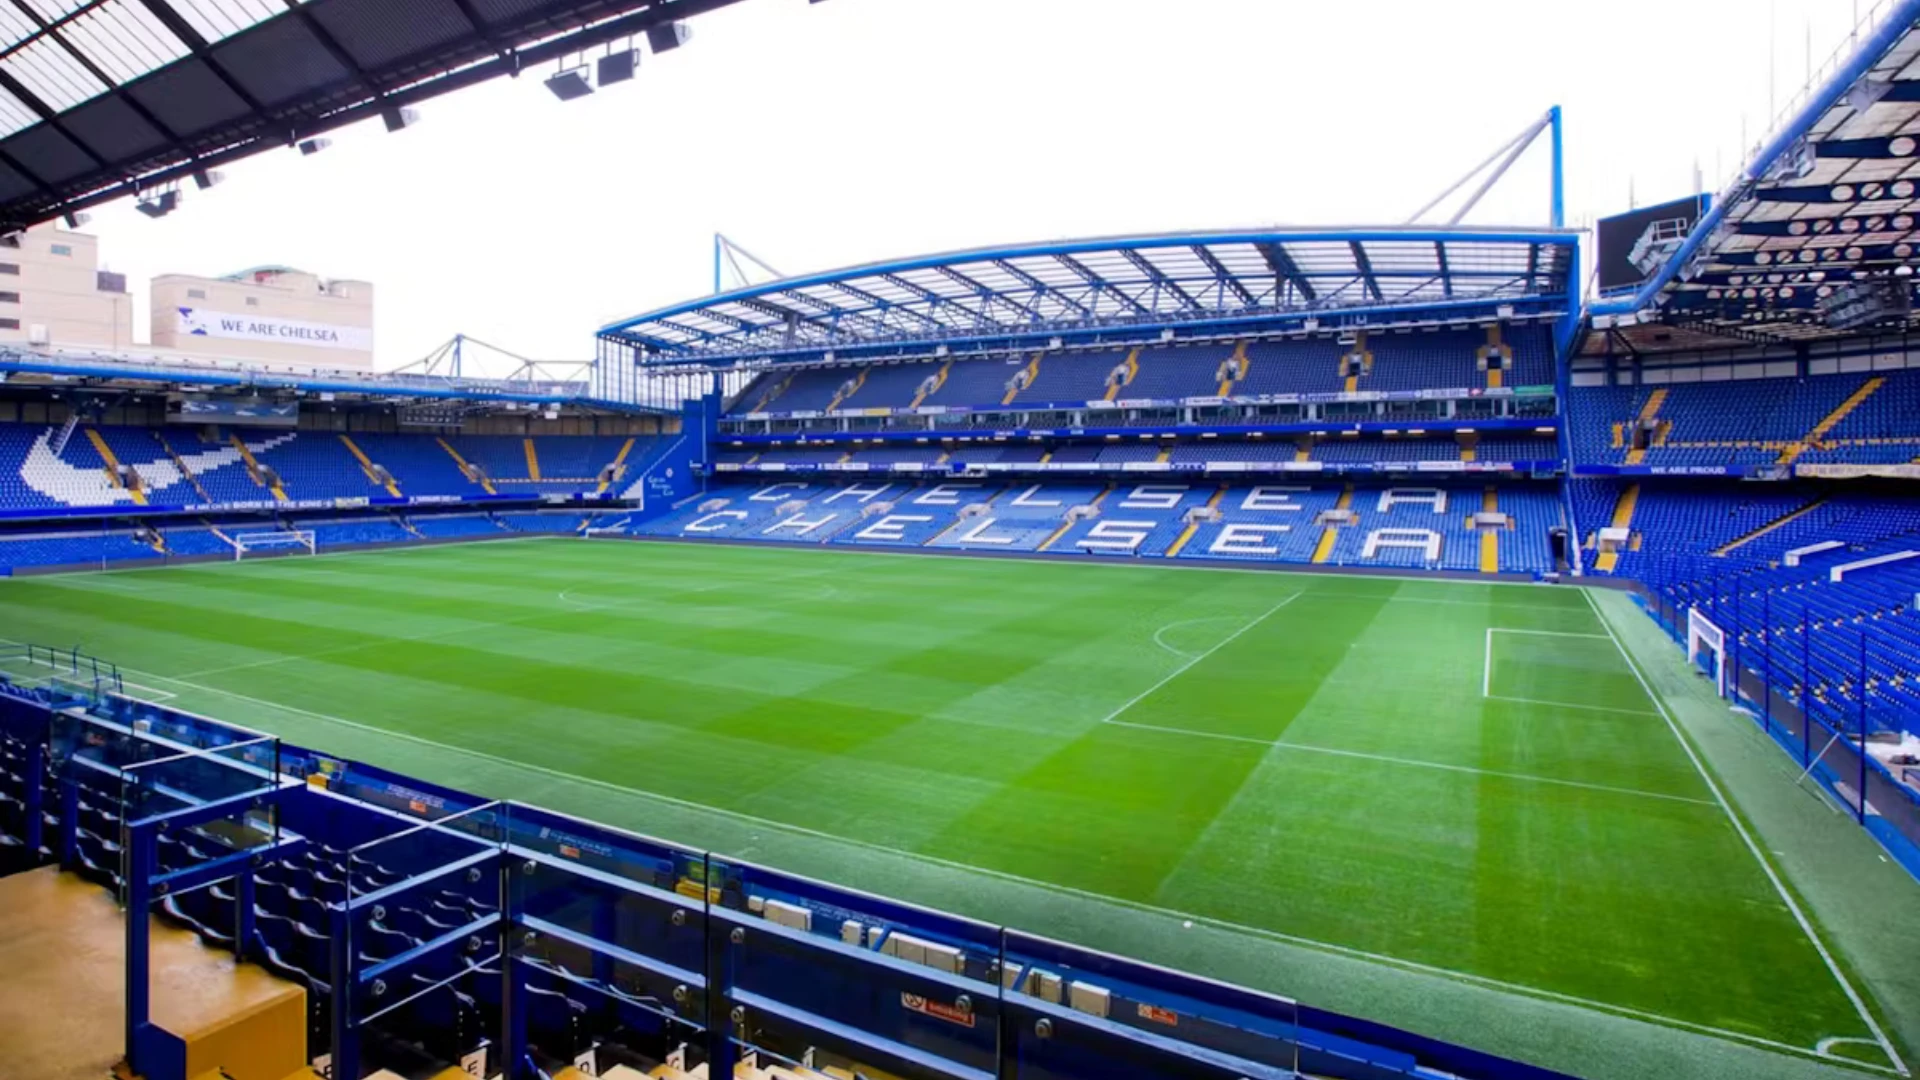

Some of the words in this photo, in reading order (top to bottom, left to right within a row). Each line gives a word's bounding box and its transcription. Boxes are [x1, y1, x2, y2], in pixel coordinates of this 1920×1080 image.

[221, 319, 243, 332] WE
[248, 322, 276, 336] ARE
[279, 325, 339, 342] CHELSEA
[1651, 466, 1666, 475] WE
[1668, 466, 1688, 475] ARE
[1689, 466, 1726, 475] PROUD
[749, 482, 1447, 513] CHELSEA
[684, 510, 1442, 561] CHELSEA
